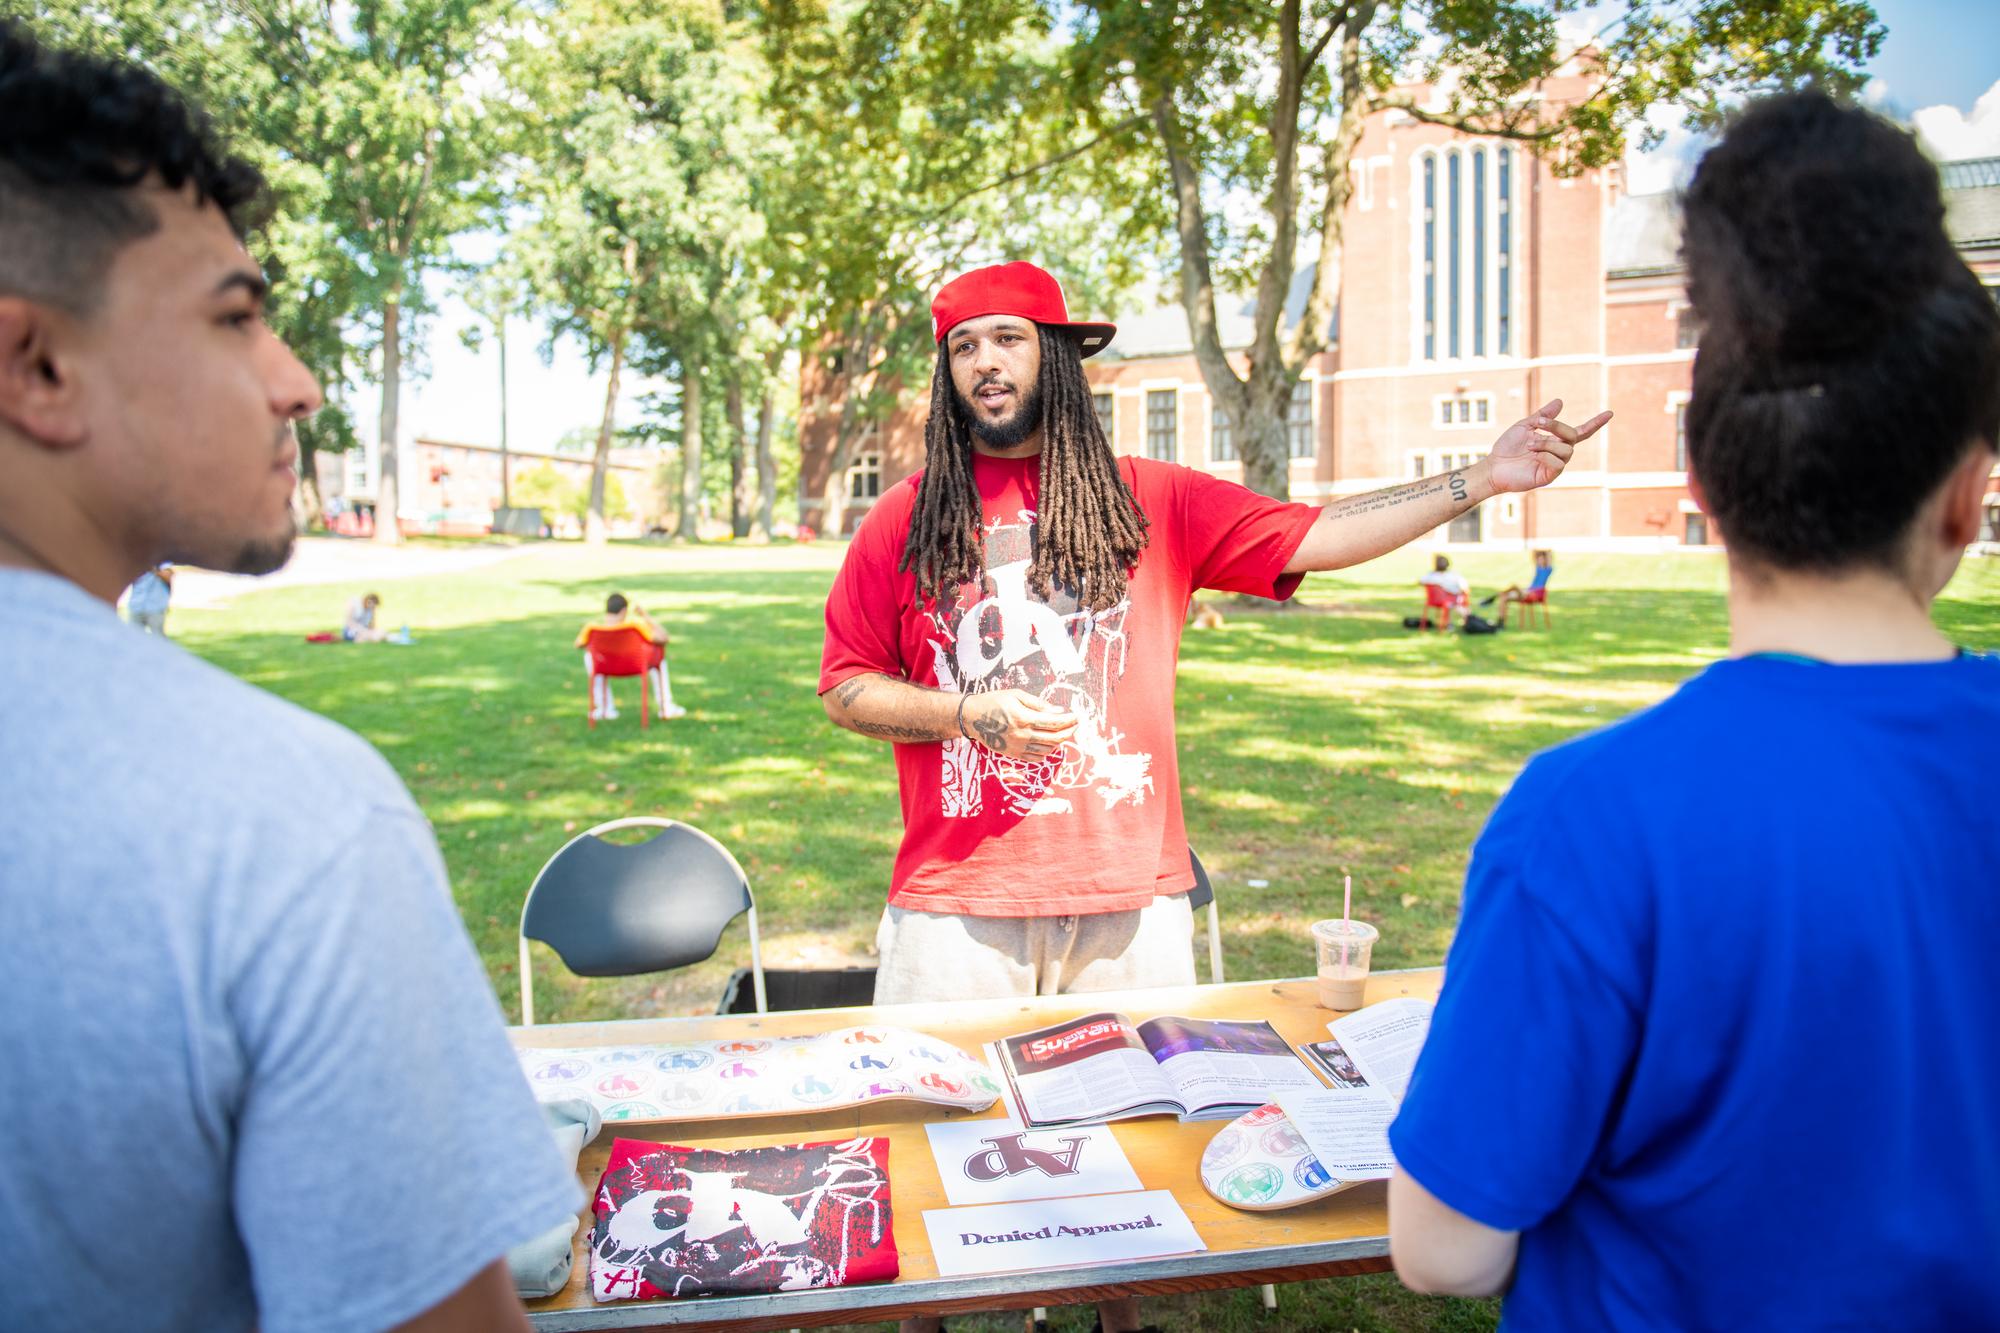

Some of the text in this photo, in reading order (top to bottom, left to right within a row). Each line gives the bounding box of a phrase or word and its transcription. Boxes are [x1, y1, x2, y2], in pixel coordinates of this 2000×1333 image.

[1346, 506, 1368, 518] child
[1406, 485, 1444, 501] survived
[1355, 495, 1389, 508] creative
[960, 1214, 1163, 1246] Denied Approval.
